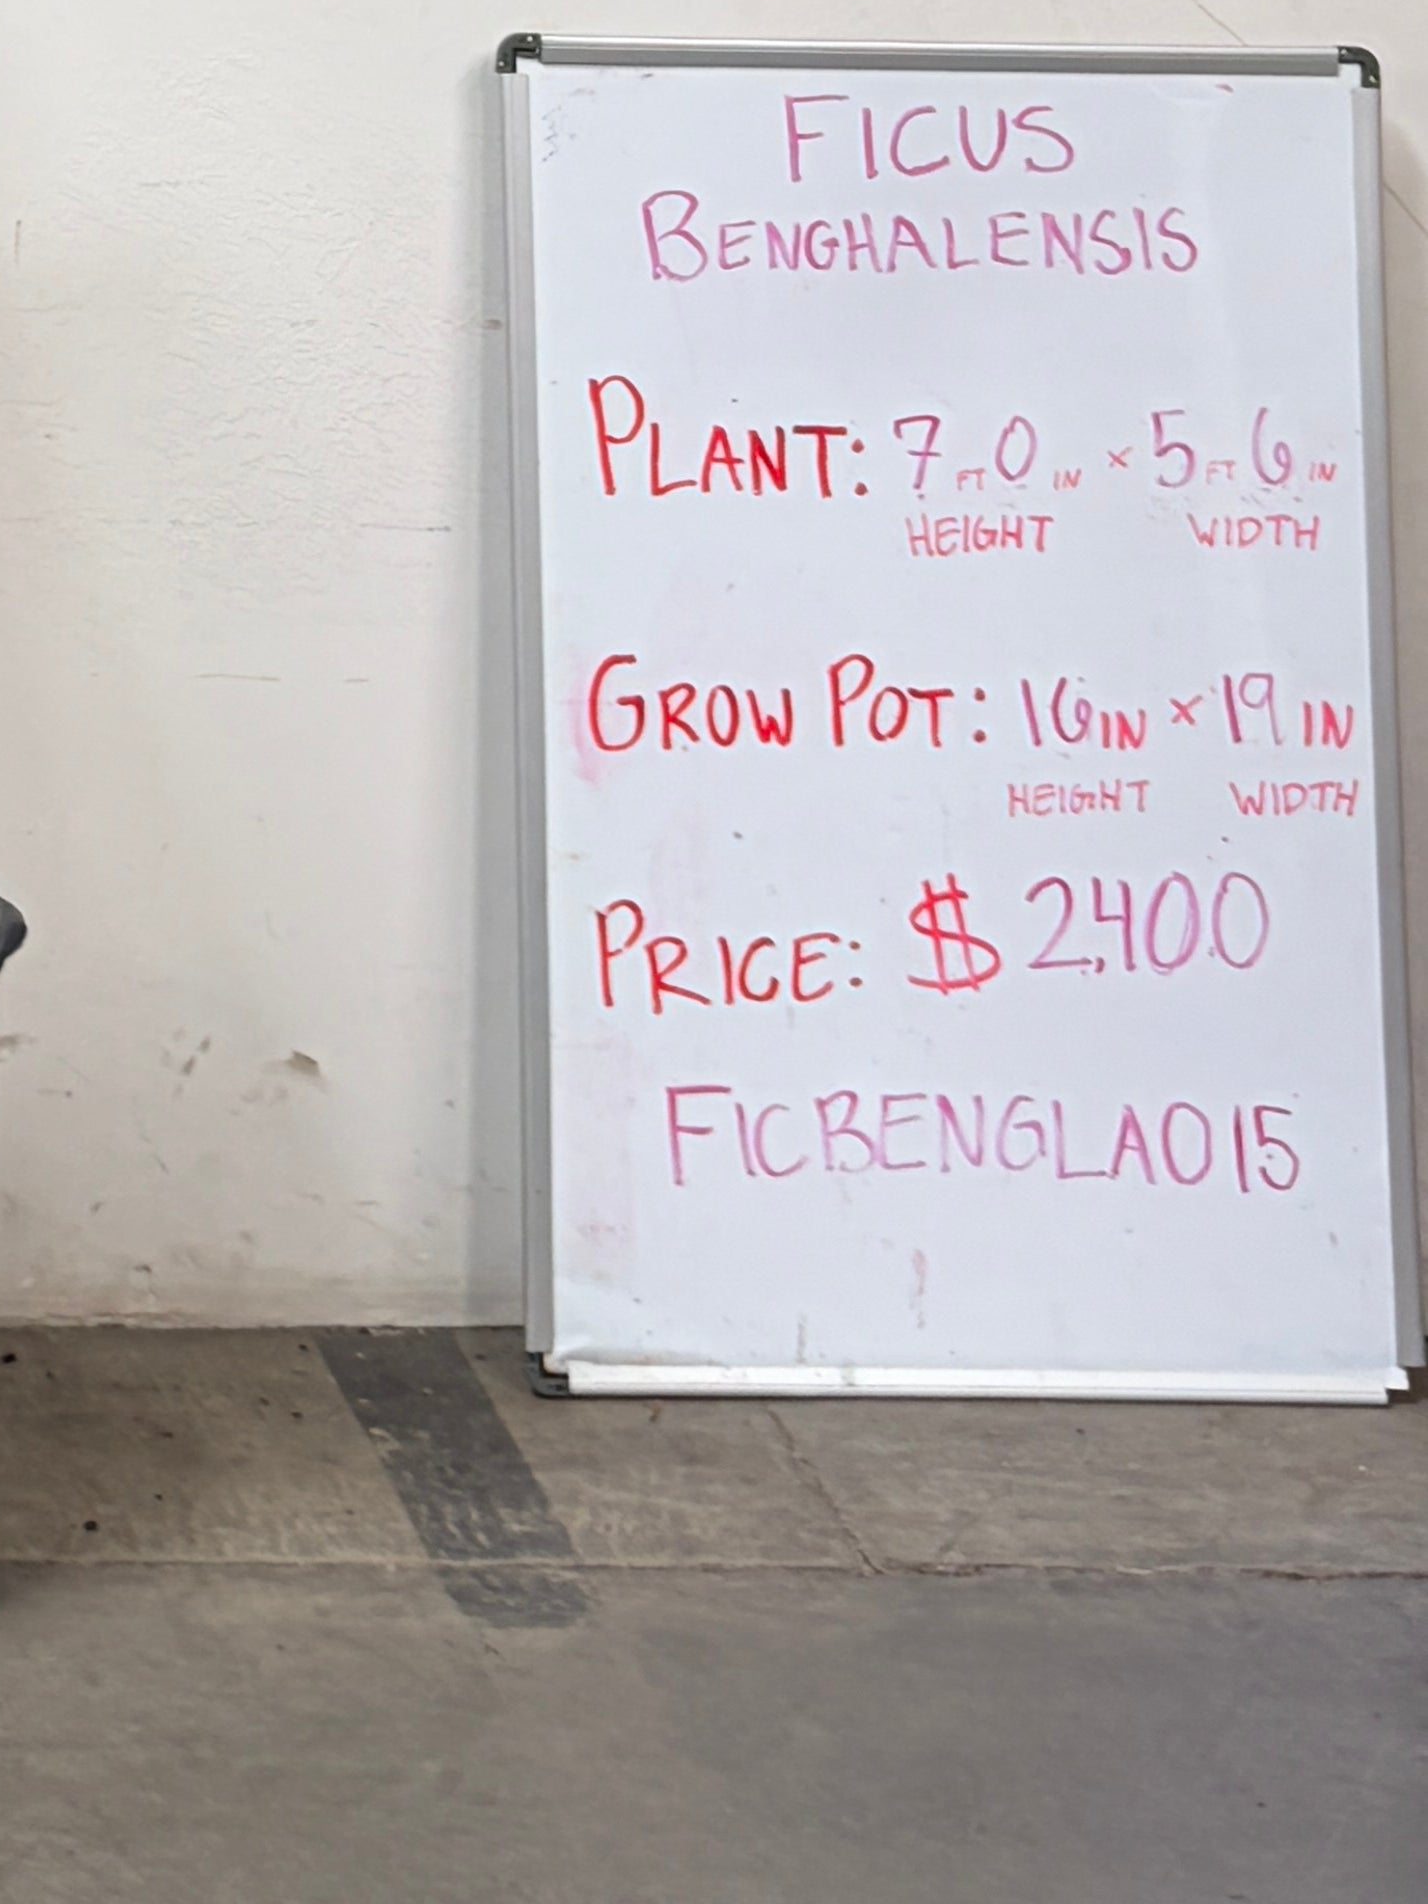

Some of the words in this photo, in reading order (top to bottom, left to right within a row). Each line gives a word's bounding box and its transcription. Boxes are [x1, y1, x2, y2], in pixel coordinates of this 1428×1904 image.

[785, 96, 1075, 181] FICUS
[642, 191, 1197, 281] BENGHALENSIS
[588, 375, 867, 498] PLANT:
[905, 514, 1053, 556] HEIGHT
[1188, 514, 1319, 550] WIDTH
[588, 654, 793, 750] GROW
[827, 654, 987, 748] POT:
[1007, 780, 1148, 817] HEIGHT
[1228, 780, 1359, 817] WIDTH
[595, 900, 862, 1014] PRICE:
